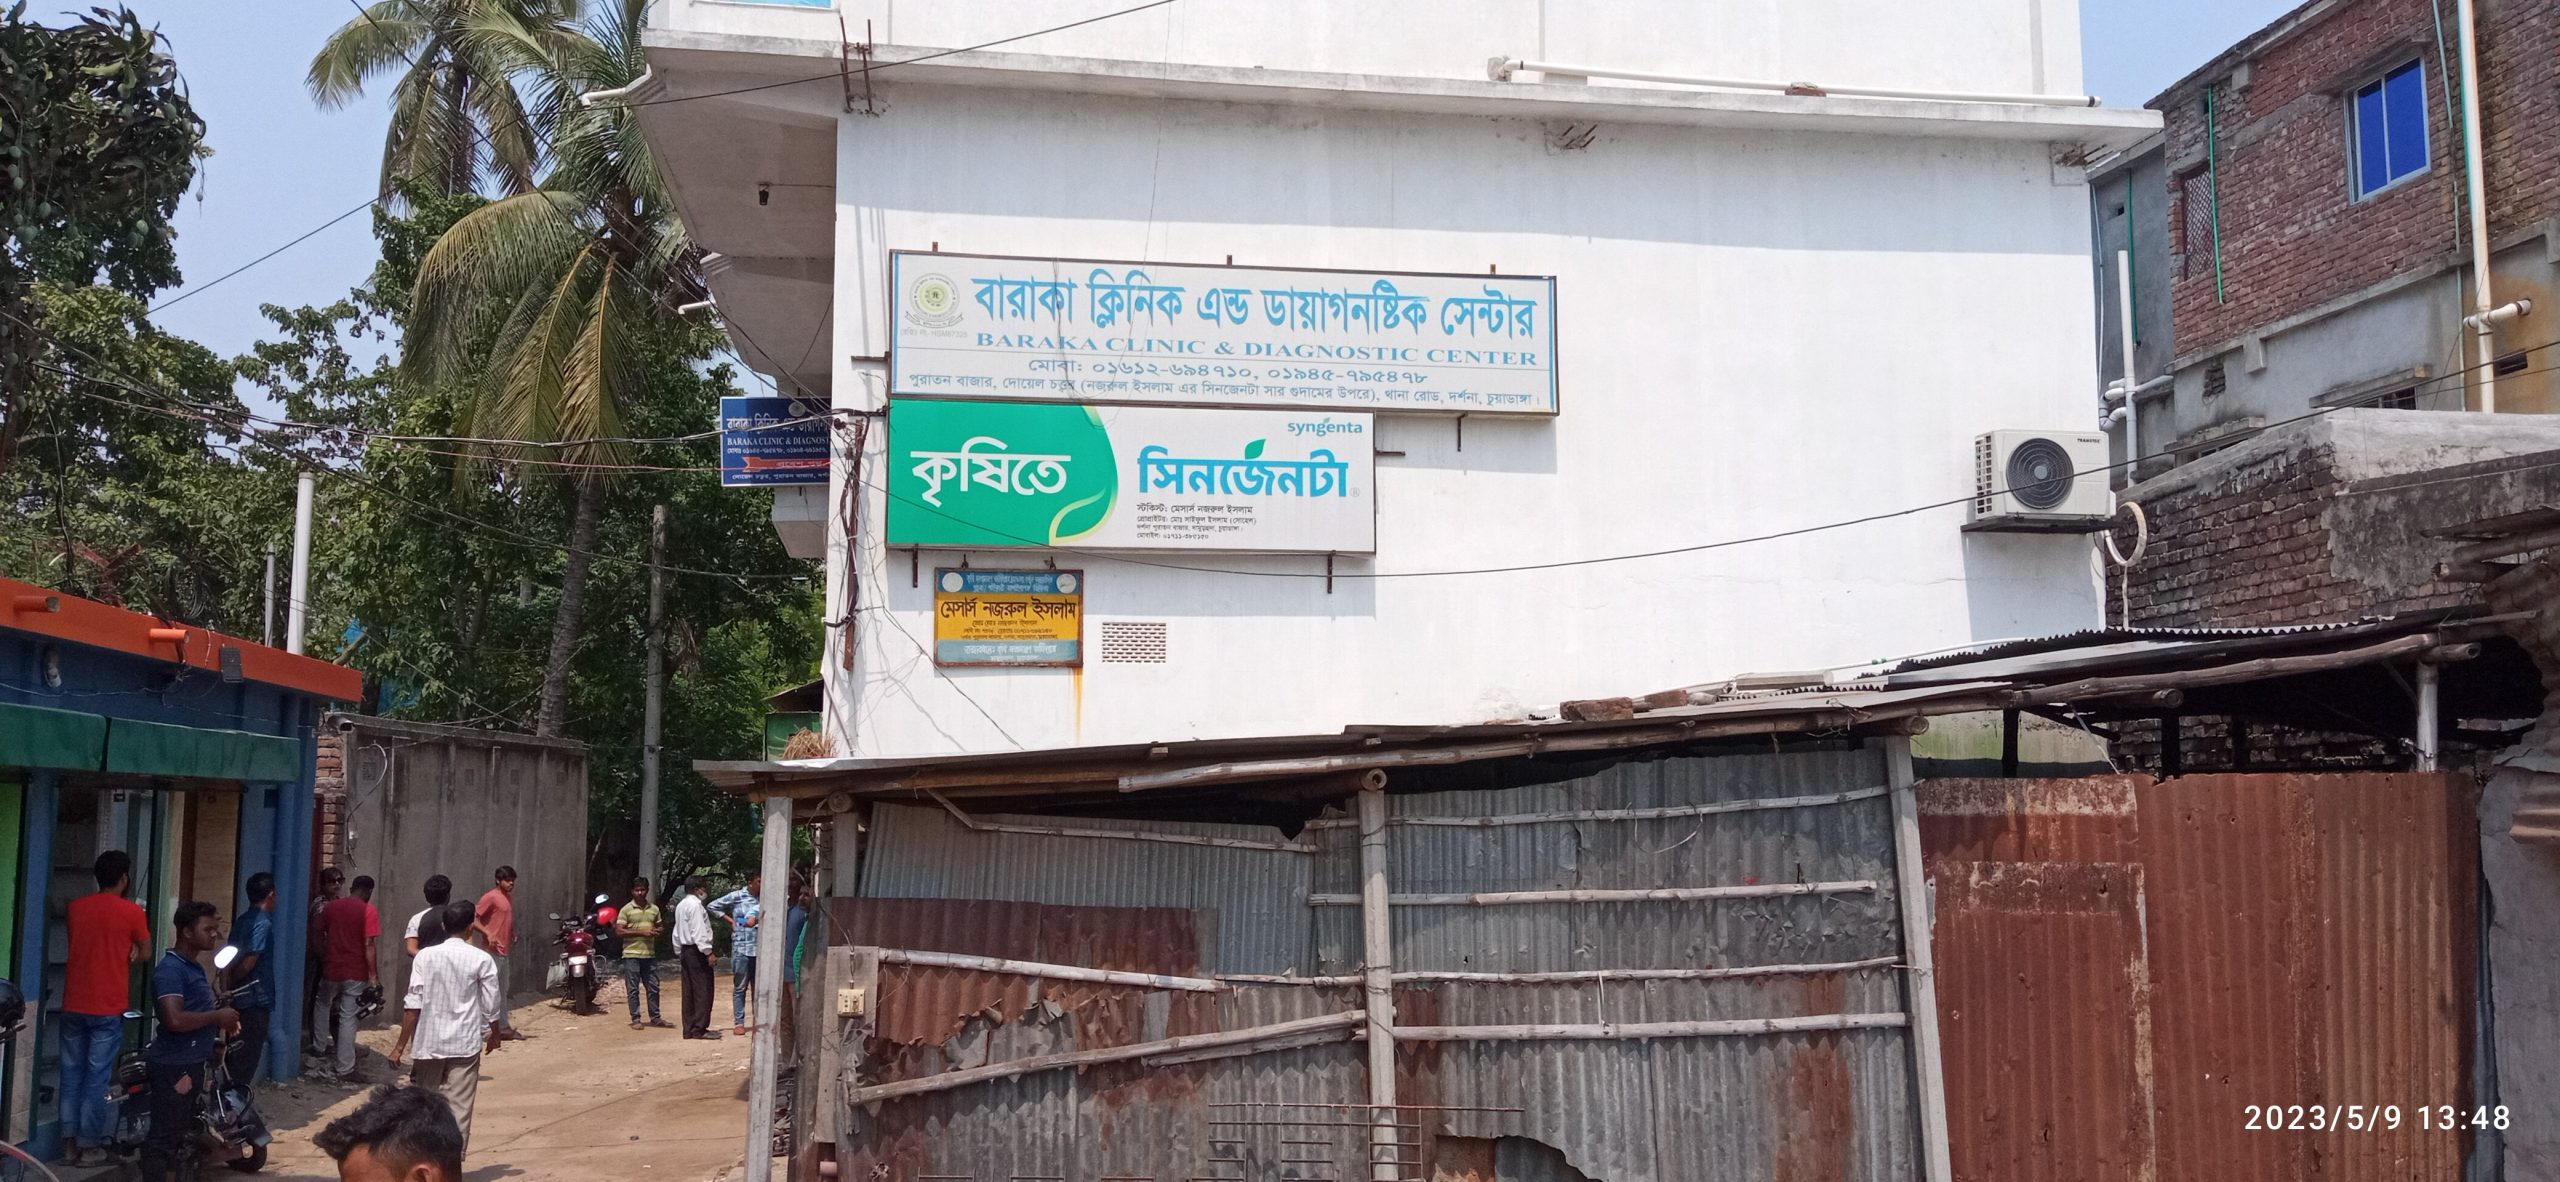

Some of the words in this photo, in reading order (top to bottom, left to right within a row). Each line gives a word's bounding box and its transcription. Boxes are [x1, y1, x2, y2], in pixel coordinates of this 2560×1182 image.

[971, 273, 1078, 325] বারাকা
[1085, 268, 1186, 328] ক্লিনিক
[1197, 288, 1253, 328] এন্ড
[1441, 284, 1537, 340] সেন্টার
[977, 333, 1097, 350] BARAKA
[1106, 338, 1205, 353] CLINIC
[1215, 341, 1235, 355] &
[1245, 343, 1419, 361] DIAGNOSTIC
[1427, 349, 1536, 365] CENTER
[909, 374, 951, 388] পুরাতন
[1002, 376, 1044, 390] দোয়েল
[1132, 380, 1173, 394] ইসলাম
[1178, 383, 1197, 395] এর
[1264, 385, 1285, 397] সার
[1290, 386, 1333, 399] গুদামের
[1385, 389, 1409, 401] থানা
[1268, 366, 1428, 384] ০১৯৪৫-৭৯৫৪৭৮
[727, 437, 758, 446] BARAKA
[758, 437, 784, 446] CLINIC
[785, 437, 792, 446] &
[1287, 420, 1363, 437] syngenta
[910, 436, 1071, 508] কৃষিতে
[1226, 504, 1253, 514] ইসলাম
[940, 596, 978, 618] মেসার্স
[983, 600, 1029, 620] নজরুল
[1031, 595, 1076, 621] ইসলাম
